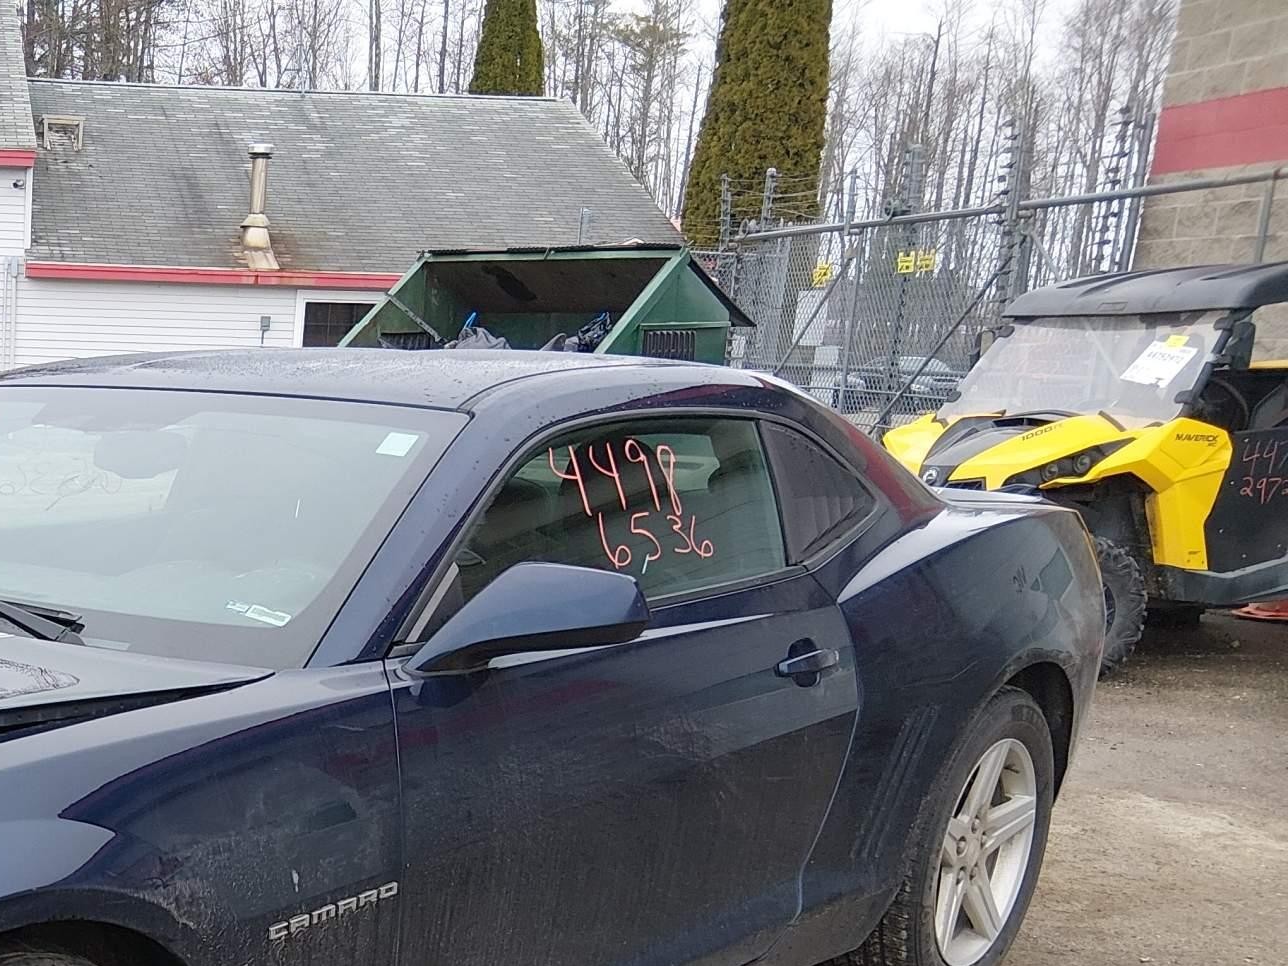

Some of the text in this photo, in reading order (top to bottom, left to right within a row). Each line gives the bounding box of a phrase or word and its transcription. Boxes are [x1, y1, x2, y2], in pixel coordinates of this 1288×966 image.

[548, 435, 682, 517] 4498
[597, 510, 714, 571] 6536
[268, 881, 398, 940] CAMARO
